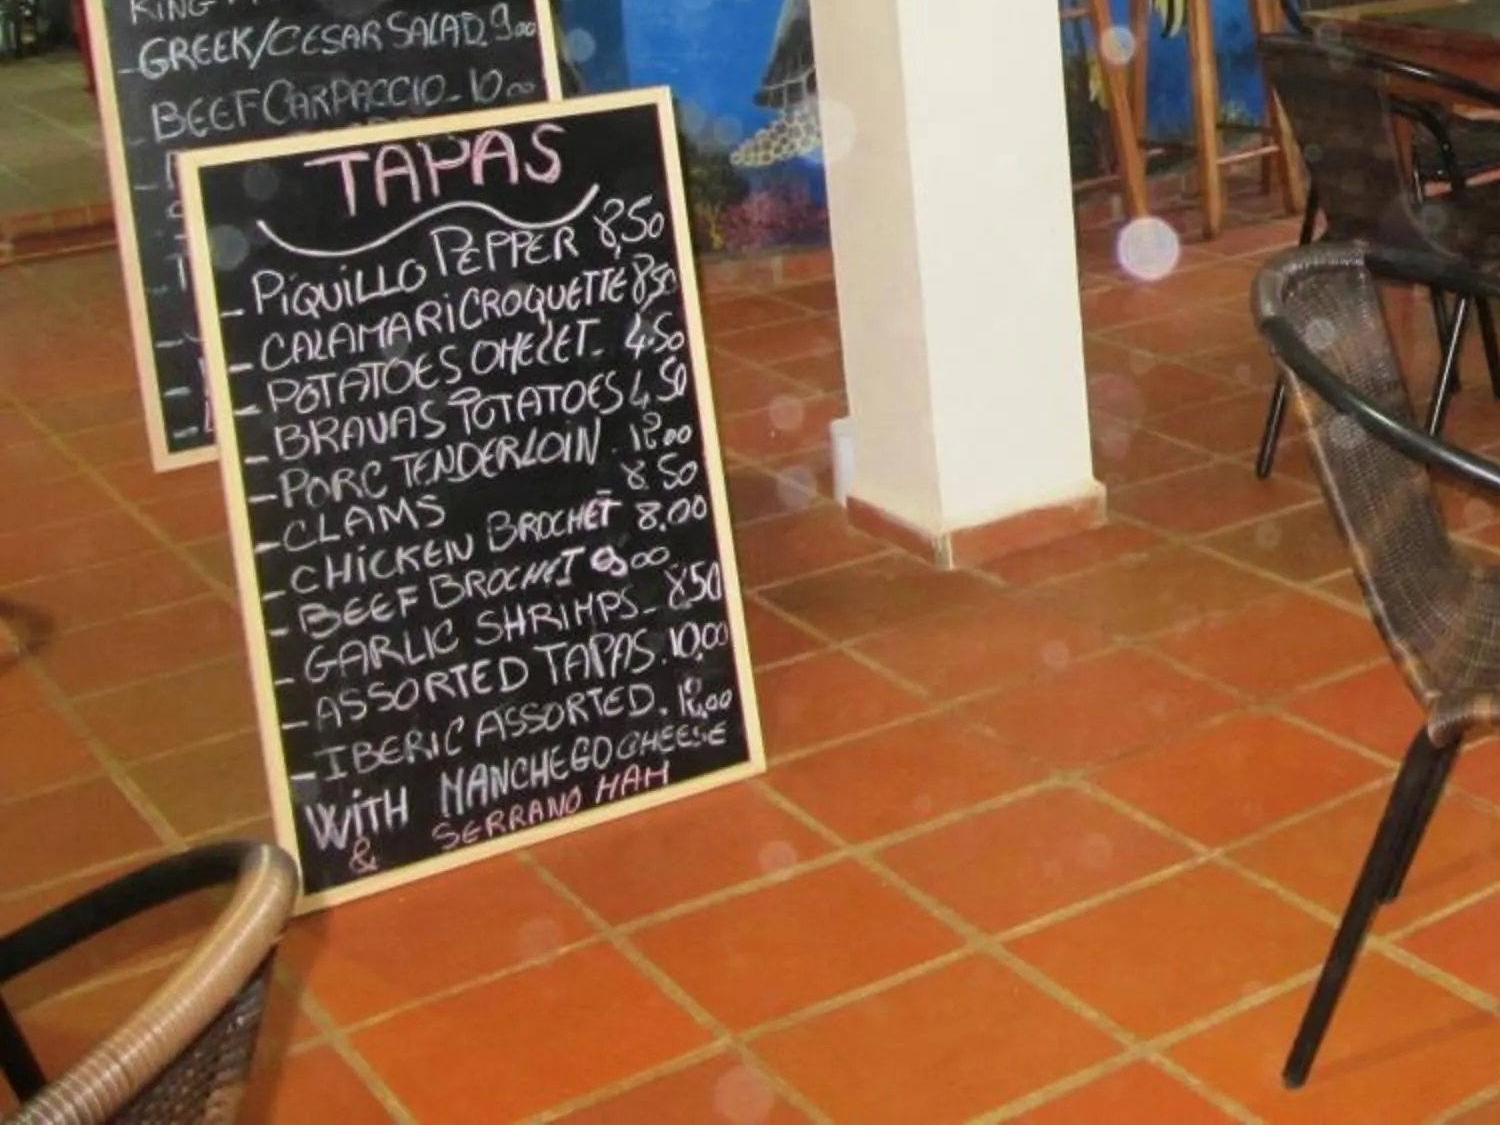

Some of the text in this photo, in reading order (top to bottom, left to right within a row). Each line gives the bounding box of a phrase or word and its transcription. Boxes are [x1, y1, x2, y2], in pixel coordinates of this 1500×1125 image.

[151, 88, 261, 143] BEEF
[304, 123, 566, 217] TAPAS
[430, 225, 580, 277] PEPPER
[266, 345, 463, 415] POTATOES
[447, 371, 624, 436] POTATOES
[282, 493, 446, 552] CLAMS
[298, 586, 420, 640] BEEF
[304, 618, 460, 684] GARLIC
[316, 655, 530, 731] ASSORTED
[532, 628, 656, 686] TAPAS
[313, 715, 465, 783] IBERIC
[474, 682, 656, 748] ASSORTED
[348, 837, 380, 874] &
[431, 786, 583, 851] SERRANO
